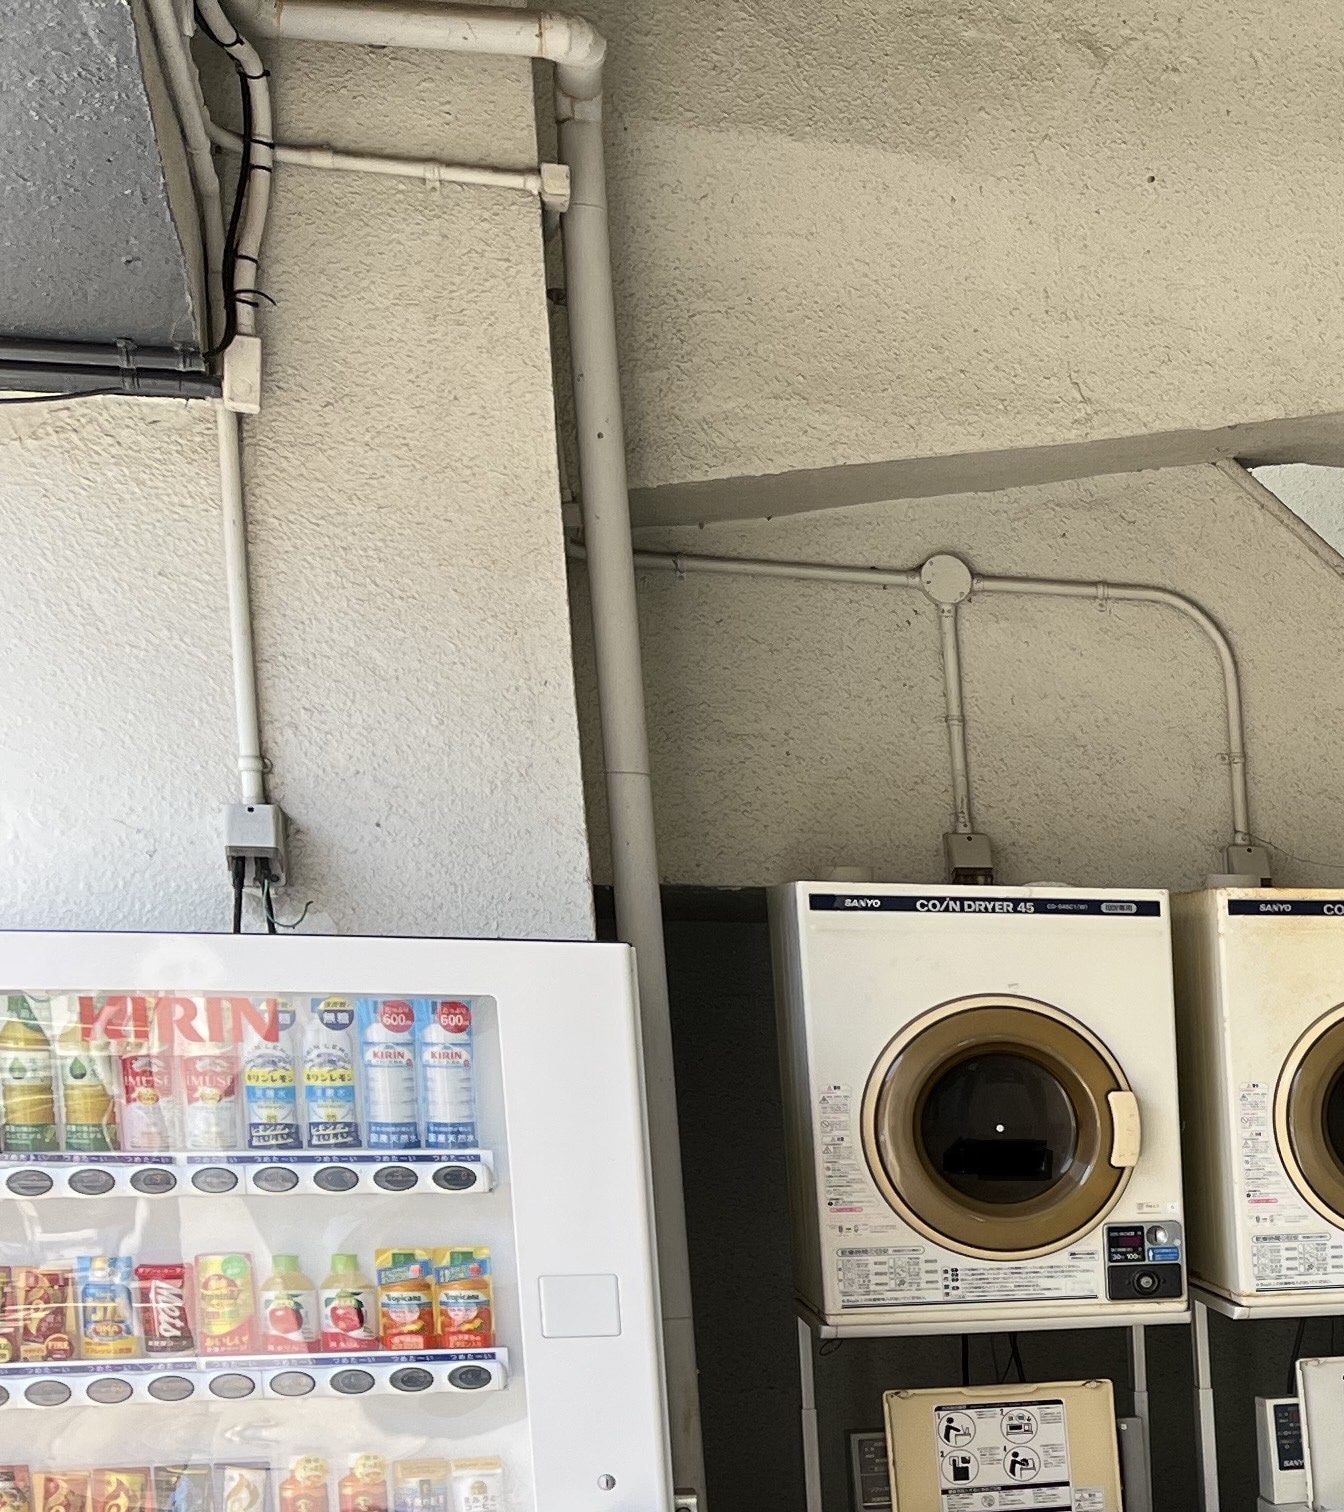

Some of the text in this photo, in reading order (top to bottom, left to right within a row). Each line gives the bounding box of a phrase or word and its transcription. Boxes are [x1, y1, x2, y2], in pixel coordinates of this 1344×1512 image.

[844, 898, 881, 908] SANYO
[963, 900, 1013, 913] DRYER
[1017, 901, 1034, 913] 45
[1259, 903, 1292, 912] SANYO
[79, 996, 280, 1042] KIRIN
[373, 1050, 405, 1060] KIRIN
[430, 1051, 463, 1060] KIRIN
[246, 1074, 294, 1083] キリンレモン
[306, 1074, 352, 1082] キリンレモン
[385, 1293, 421, 1303] Tropicana
[444, 1293, 479, 1302] Tropicana
[149, 1279, 185, 1338] Mets
[1283, 1459, 1304, 1467] SANY
